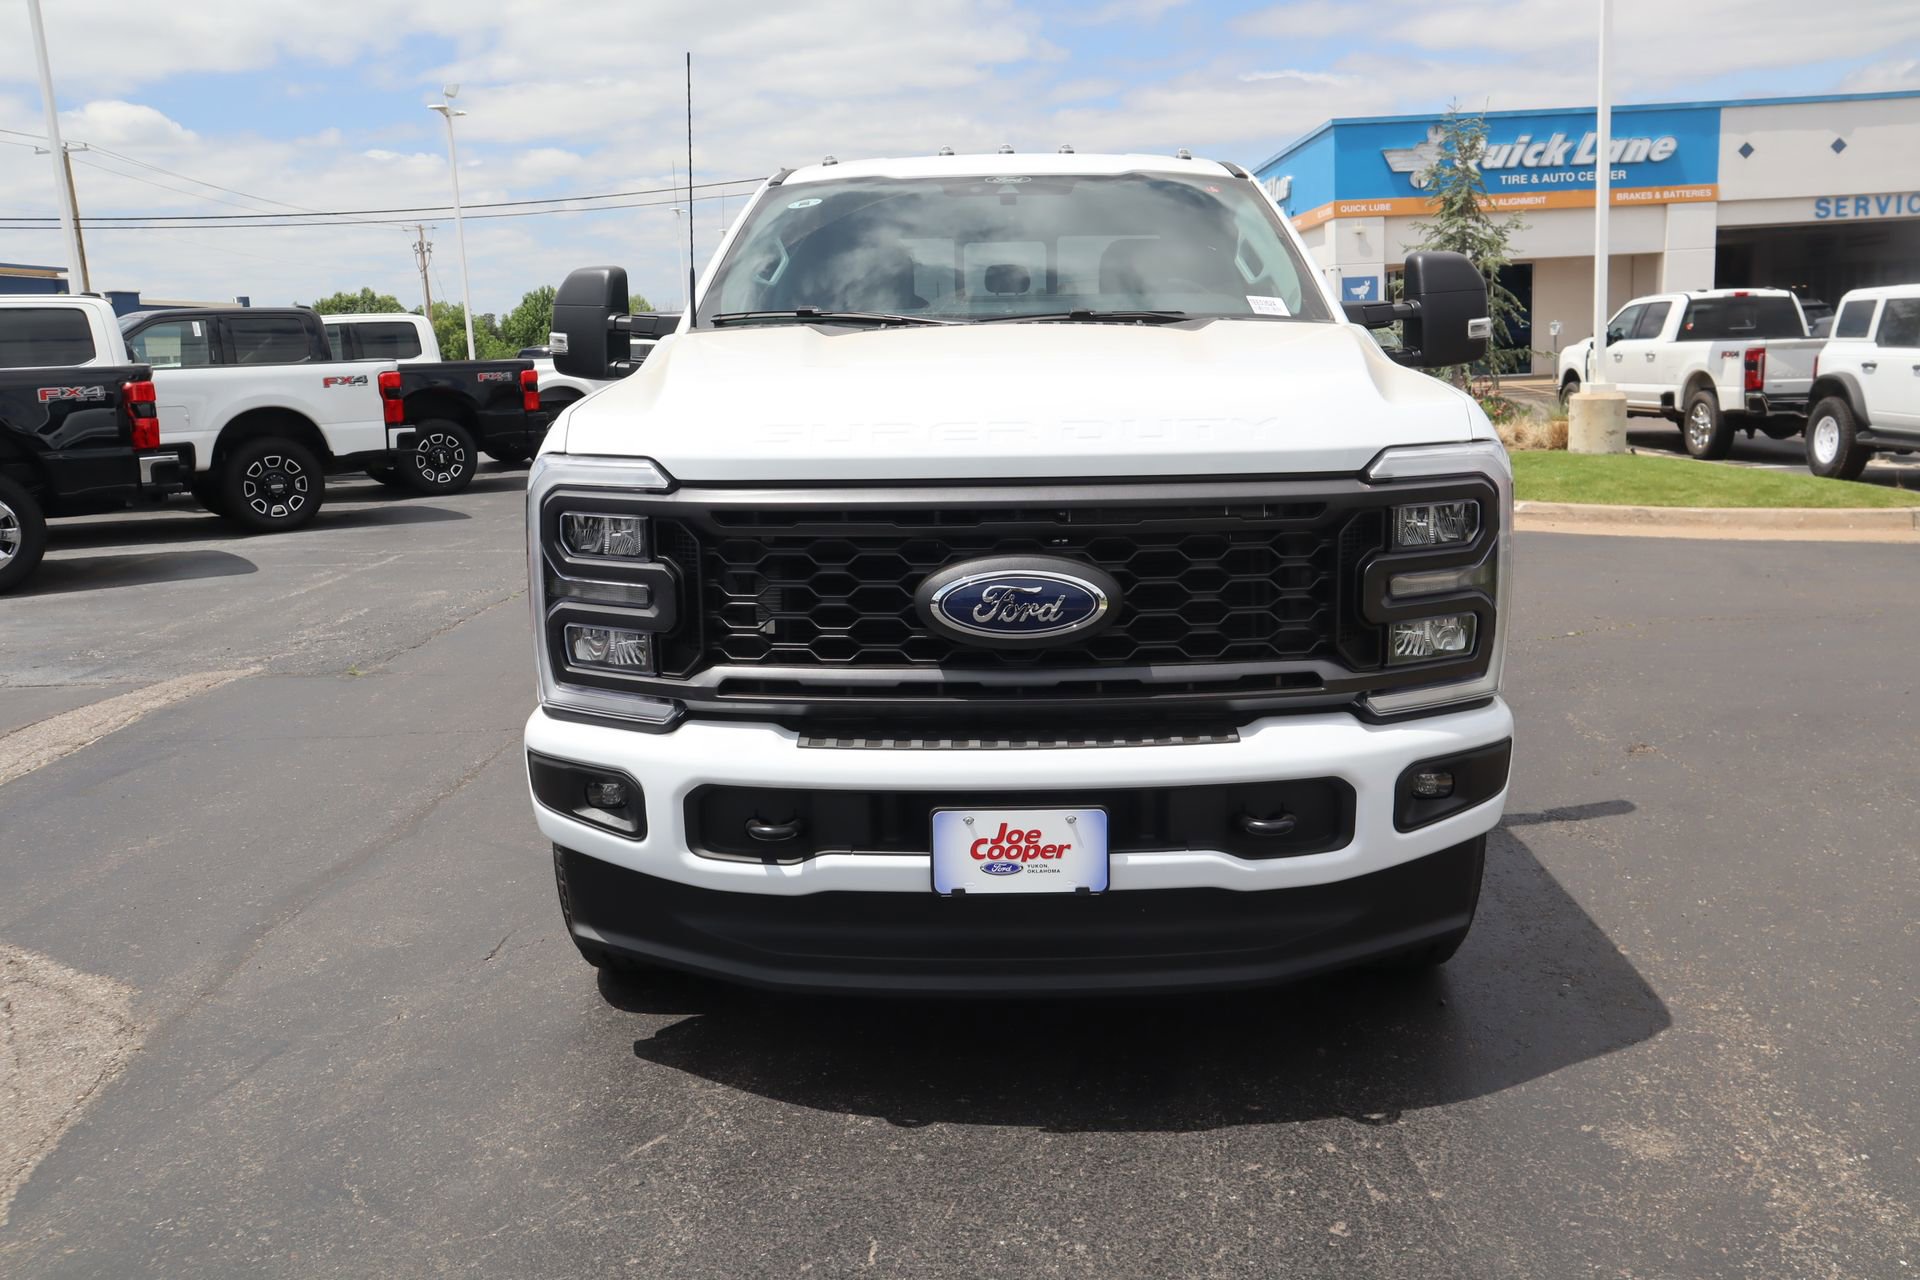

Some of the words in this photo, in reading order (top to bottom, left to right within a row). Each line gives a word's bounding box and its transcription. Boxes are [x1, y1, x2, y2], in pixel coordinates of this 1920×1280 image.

[1500, 174, 1528, 185] TIRE
[1530, 173, 1539, 184] &
[1541, 172, 1575, 183] AUTO
[1577, 170, 1627, 181] CEER
[1498, 196, 1546, 206] ALIGNMENT
[1616, 191, 1653, 201] BRAKES
[1664, 189, 1712, 198] BATTERIES
[1340, 204, 1367, 213] QUICK
[1369, 203, 1392, 212] LUBE
[323, 375, 368, 388] FX4
[37, 385, 105, 403] FX4
[752, 420, 1042, 447] SUPER
[1060, 415, 1279, 442] DUTY
[972, 584, 1066, 623] Ford
[990, 822, 1042, 846] Joe
[970, 838, 1072, 863] Cooper
[991, 863, 1013, 873] Ford
